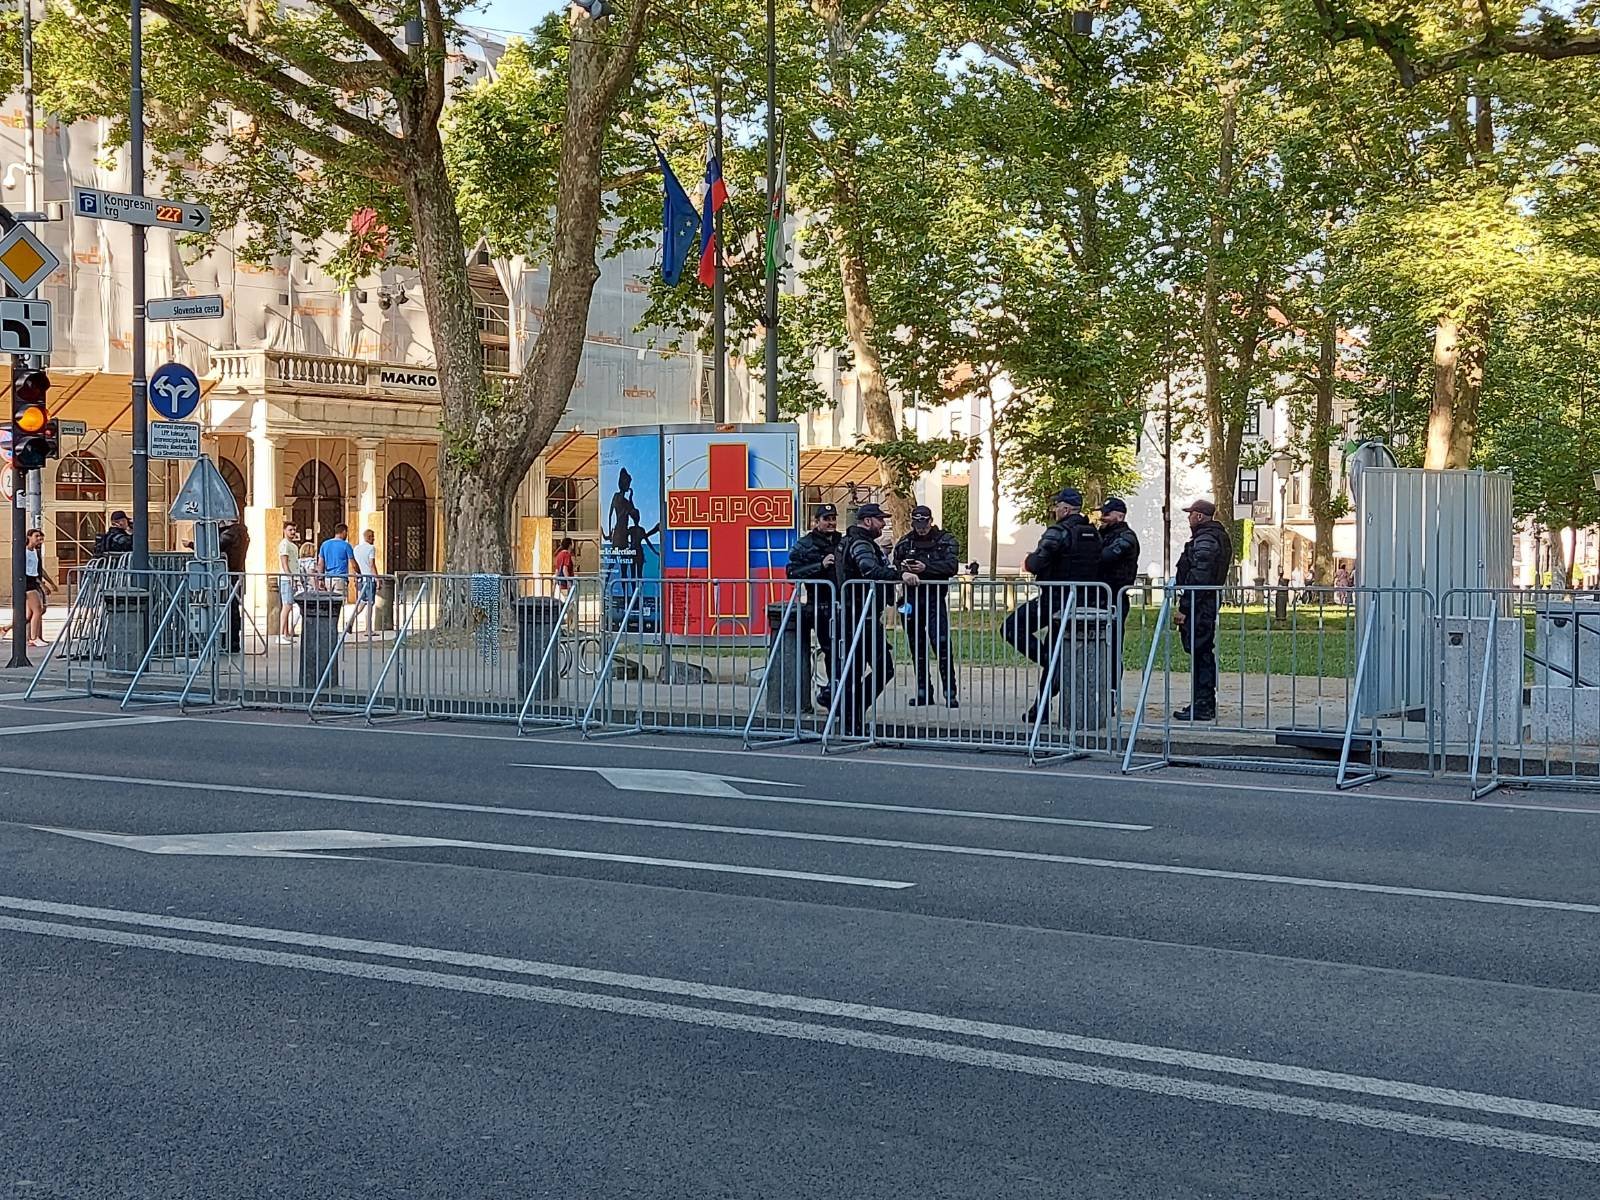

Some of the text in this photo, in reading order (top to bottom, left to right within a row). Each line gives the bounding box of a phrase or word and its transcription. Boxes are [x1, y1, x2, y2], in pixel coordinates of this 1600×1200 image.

[103, 193, 154, 211] Kongresni
[157, 206, 181, 222] 227
[104, 205, 119, 219] trg
[173, 305, 220, 315] Slovenska cesta
[381, 371, 437, 387] MAKRO
[670, 496, 790, 523] HLAPCI
